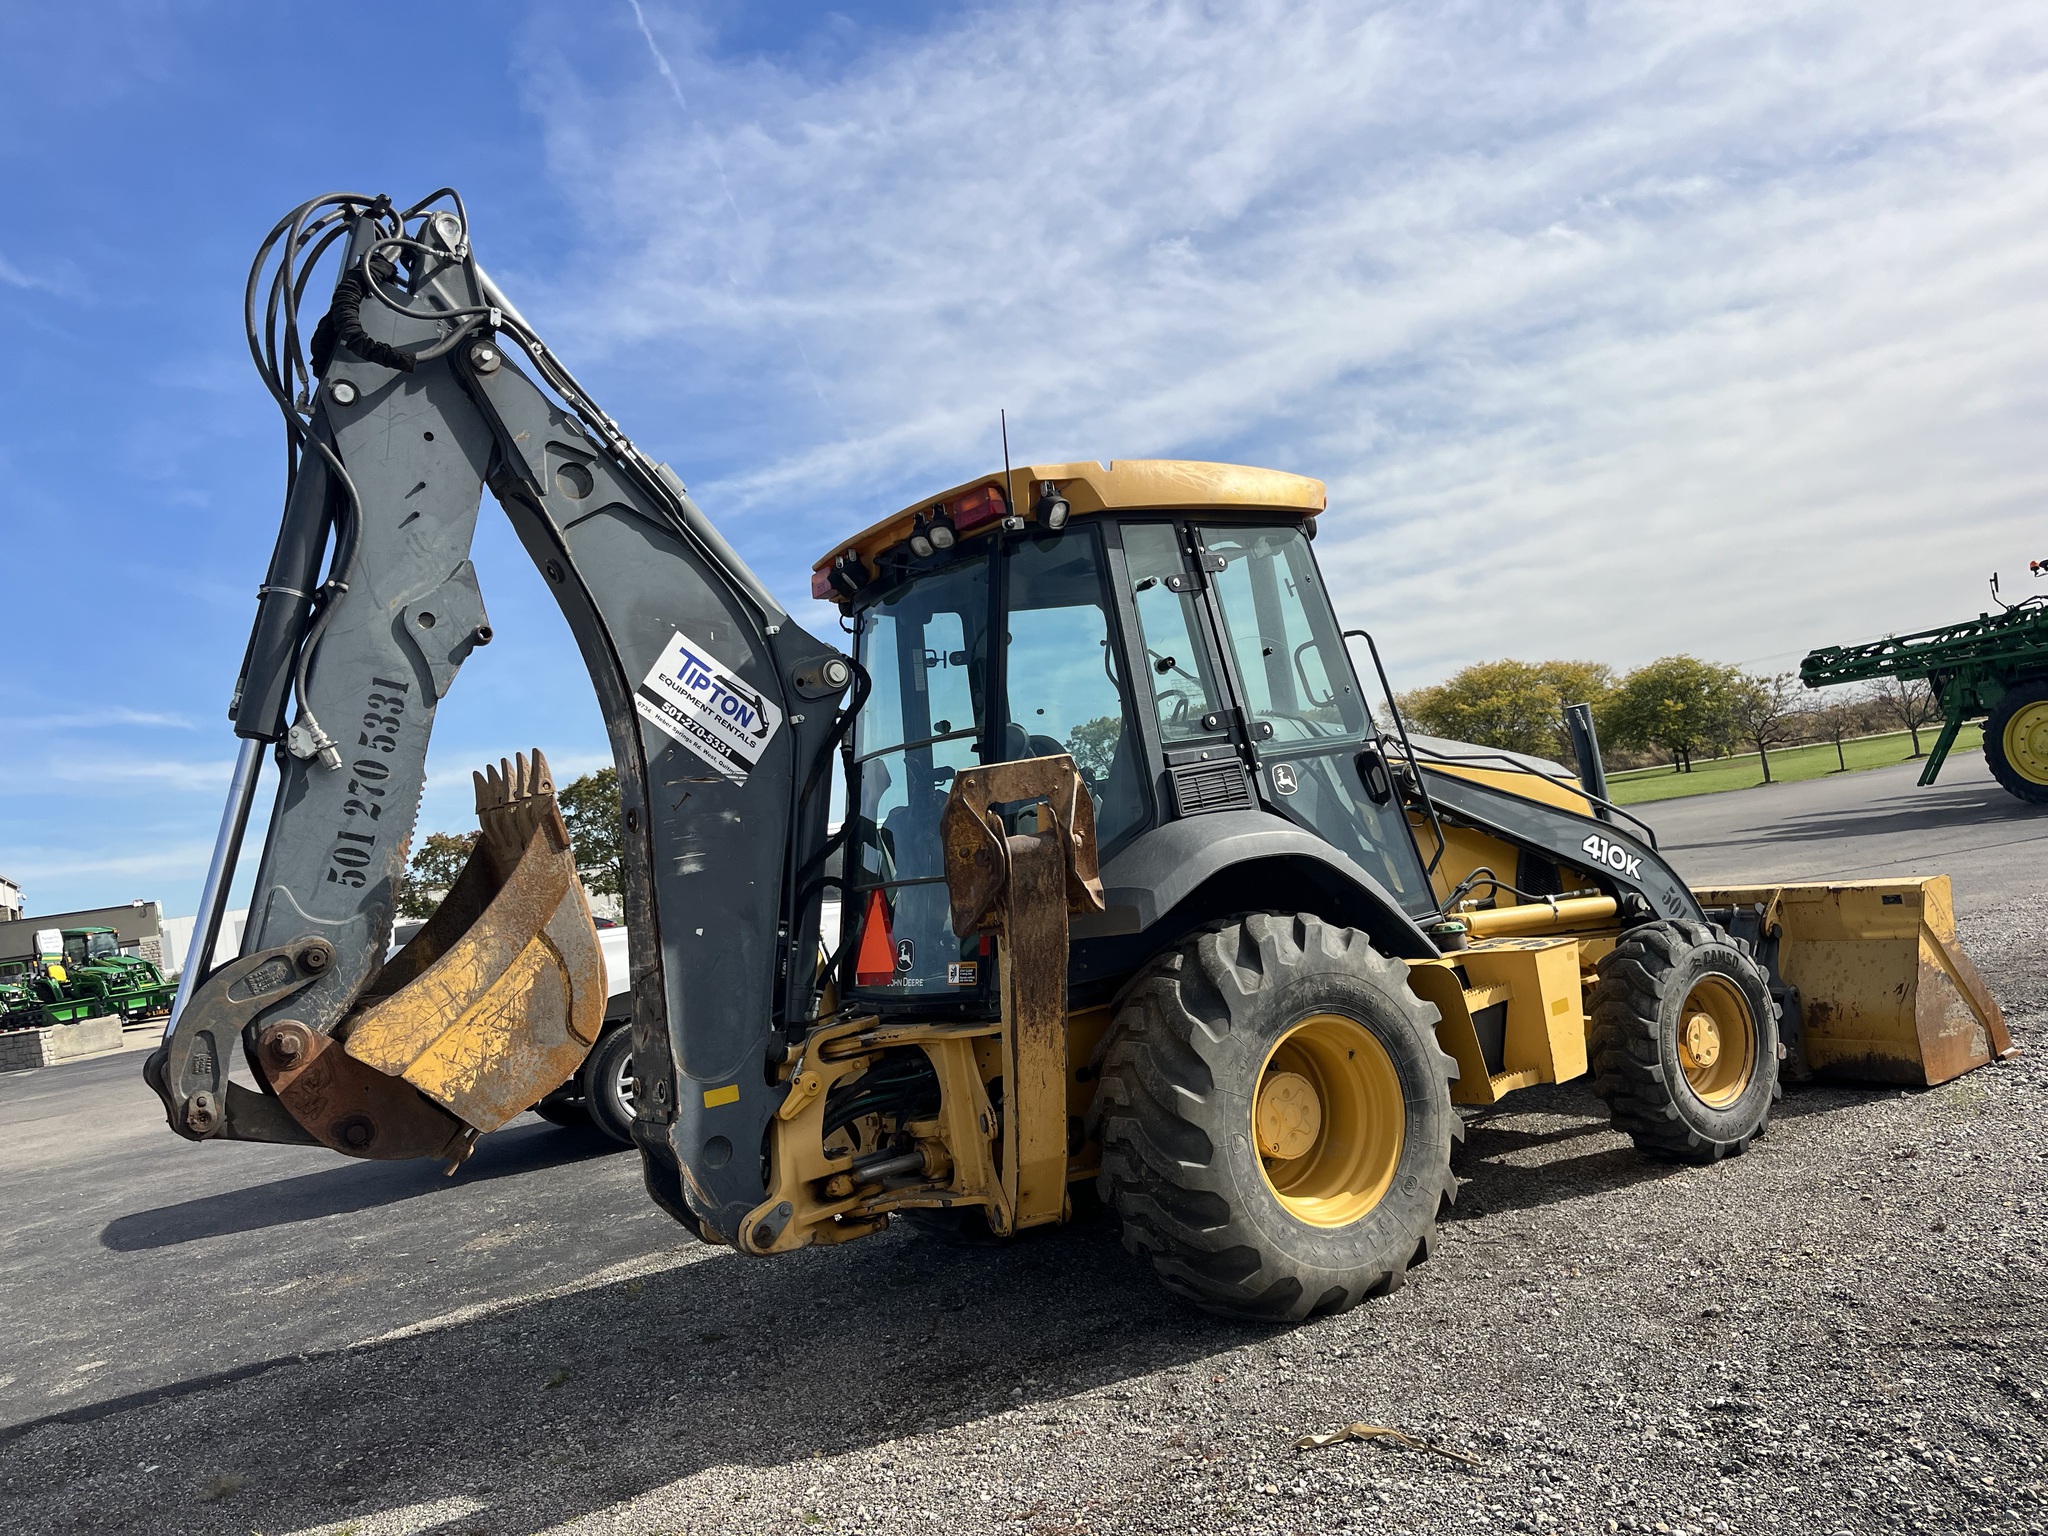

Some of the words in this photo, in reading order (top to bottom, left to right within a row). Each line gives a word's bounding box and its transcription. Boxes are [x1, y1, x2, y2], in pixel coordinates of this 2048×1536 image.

[358, 677, 409, 753] 5331
[658, 672, 717, 716] EQUIPMENT
[714, 715, 757, 749] RENTALS
[676, 646, 756, 729] TIPTON
[655, 713, 672, 728] Heber
[672, 726, 693, 745] Springs
[693, 741, 702, 752] Rd.
[703, 748, 718, 763] West,
[661, 701, 733, 758] 501-270-5331
[342, 759, 390, 821] 270
[326, 830, 376, 889] 501
[1582, 833, 1643, 882] 410K
[887, 977, 902, 987] OHN
[902, 976, 924, 987] DEERE
[1703, 949, 1739, 968] CAMSO
[1336, 981, 1380, 1009] TRACTION
